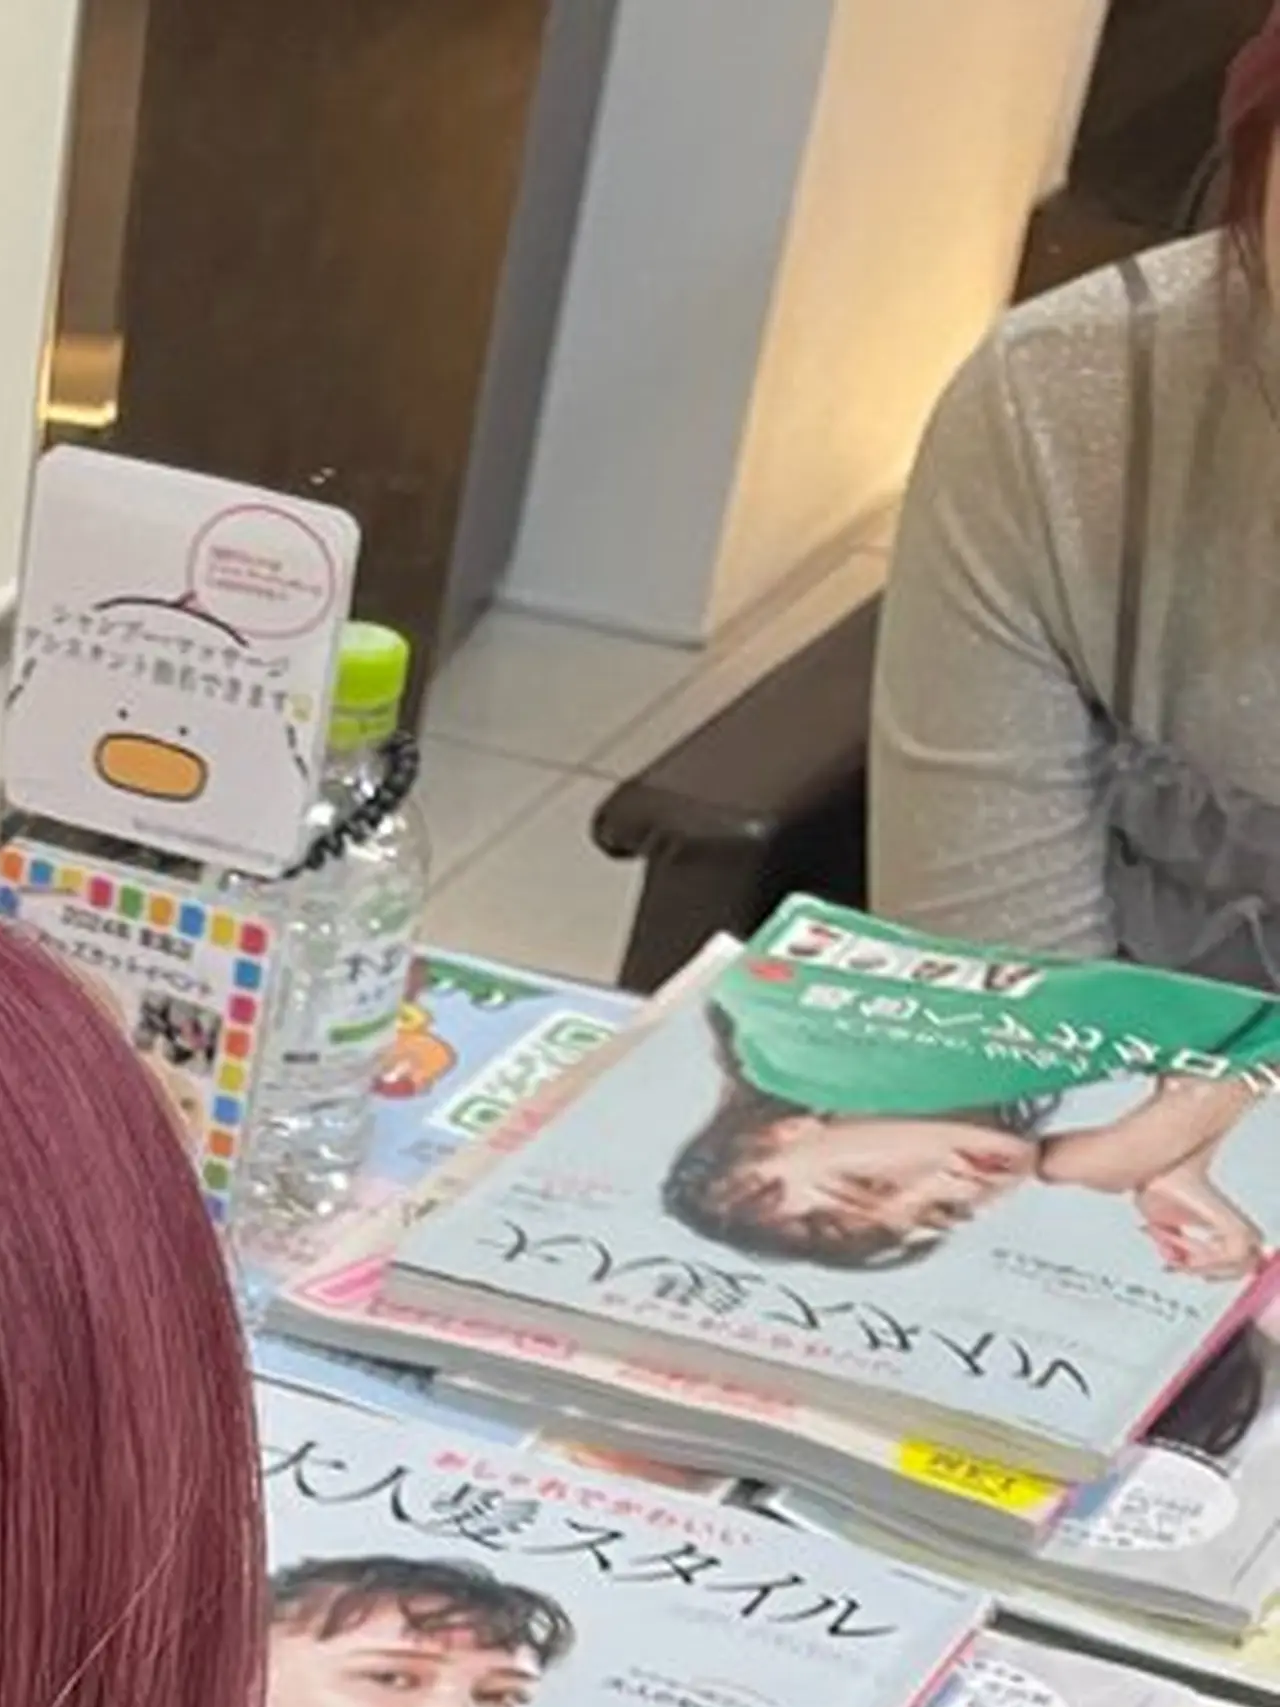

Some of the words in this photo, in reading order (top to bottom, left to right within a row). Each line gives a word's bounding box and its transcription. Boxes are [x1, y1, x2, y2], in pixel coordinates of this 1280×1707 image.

[264, 1439, 897, 1640] 大人髪スタイル
